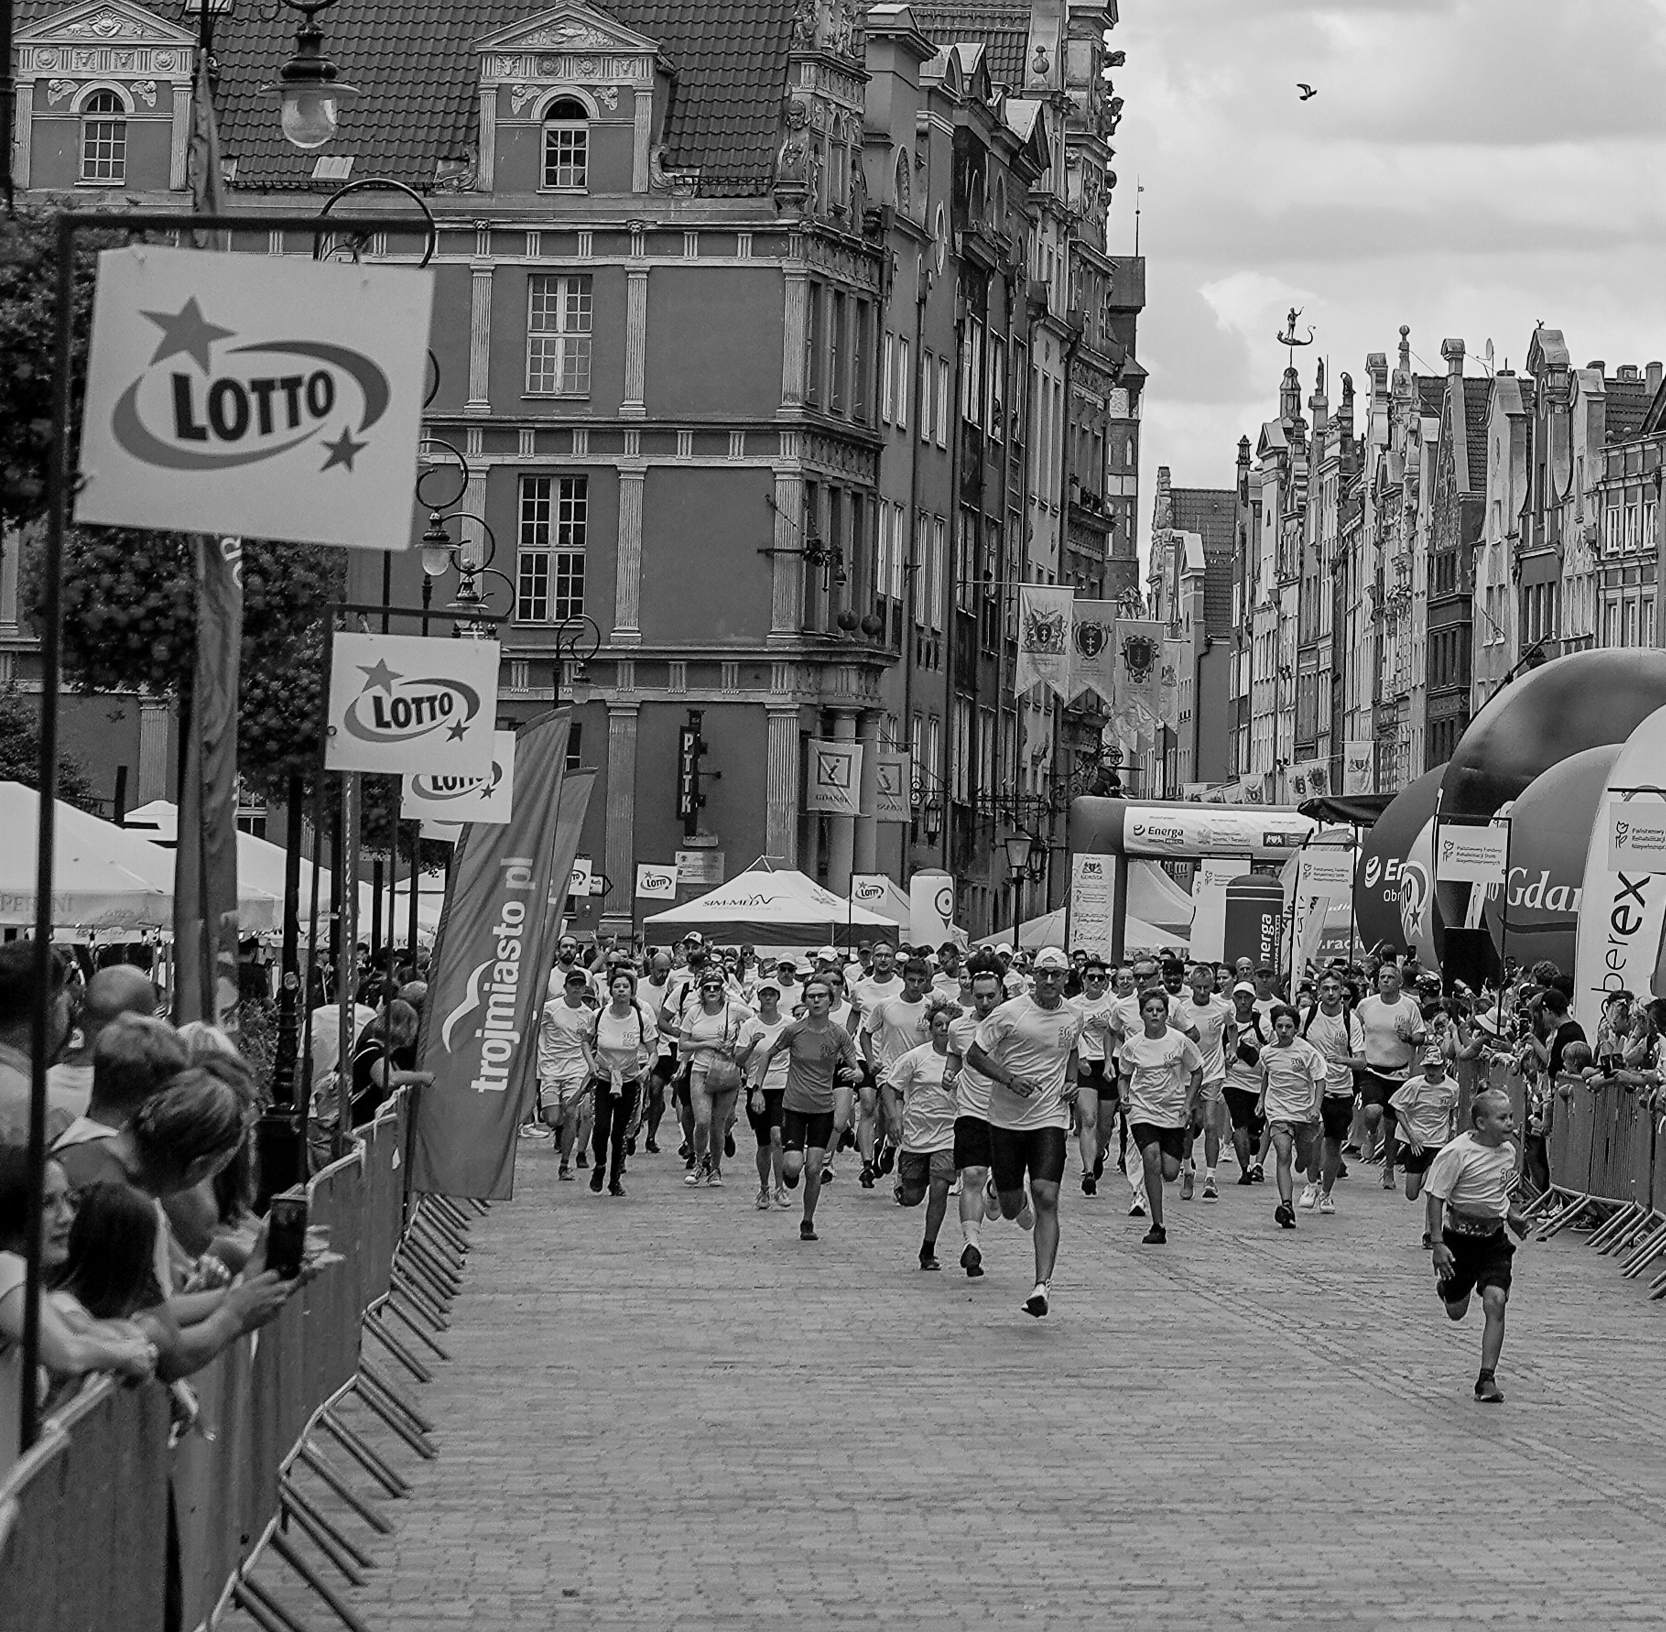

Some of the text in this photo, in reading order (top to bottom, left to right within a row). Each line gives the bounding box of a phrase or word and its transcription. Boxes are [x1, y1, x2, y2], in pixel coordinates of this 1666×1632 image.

[171, 368, 335, 442] LOTTO
[372, 692, 454, 729] LOTTO
[681, 732, 695, 814] PTTK
[1148, 826, 1184, 839] Energa
[1507, 866, 1583, 913] Gda
[1260, 913, 1275, 962] nerga
[1590, 870, 1653, 1015] berex
[470, 900, 526, 1094] trojmiasto
